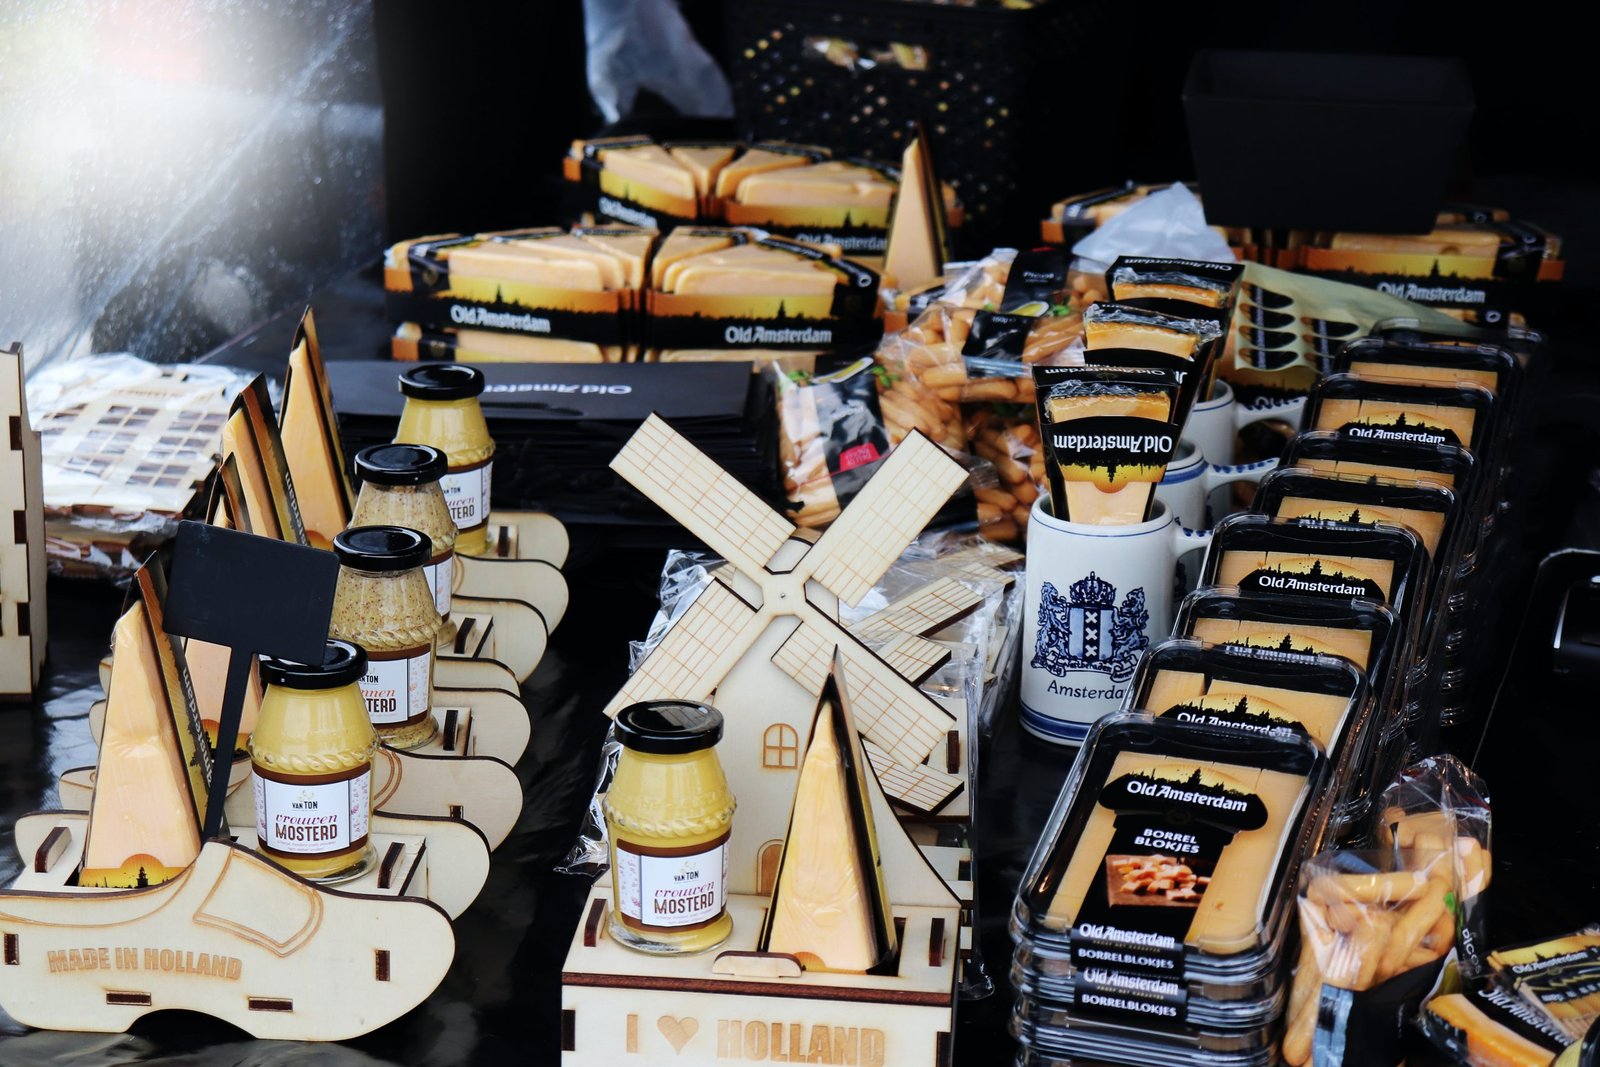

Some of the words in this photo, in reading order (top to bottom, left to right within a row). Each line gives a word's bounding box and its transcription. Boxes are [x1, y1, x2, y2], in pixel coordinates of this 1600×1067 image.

[823, 234, 888, 250] Amsterda
[1405, 283, 1486, 303] Amsterdam
[451, 304, 477, 324] Old
[475, 307, 551, 333] Amsterdam
[725, 325, 752, 343] Old
[752, 326, 832, 343] Amsterdam
[484, 383, 580, 393] Amster
[581, 384, 632, 394] Old
[1053, 434, 1142, 453] Amsterdam
[1143, 435, 1173, 453] Old
[1349, 428, 1373, 438] Old
[1372, 429, 1446, 444] Amsterdam
[451, 504, 475, 520] TERD
[1259, 575, 1285, 588] Old
[1285, 578, 1366, 596] Amsterdam
[366, 675, 379, 683] TON
[1047, 680, 1124, 699] Amsterda
[366, 698, 397, 713] TERD
[304, 801, 318, 809] TON
[1126, 780, 1158, 797] Old
[1156, 784, 1248, 812] Amsterdam
[275, 813, 338, 825] vrouwen
[275, 822, 338, 842] MOSTERD
[1143, 828, 1198, 844] BORREL
[1134, 836, 1200, 854] BLOKJES
[686, 870, 700, 880] TON
[654, 881, 715, 898] vrouwen
[654, 891, 715, 915] MOSTERD
[1079, 923, 1105, 939] Old
[1102, 926, 1176, 949] Amsterdam
[47, 947, 111, 973] MADE
[115, 947, 139, 970] IN
[144, 948, 243, 980] HOLLAND
[1078, 948, 1175, 969] BORRELBLOKJES
[1083, 967, 1109, 984] Old
[1106, 971, 1179, 995] Amsterdam
[1081, 993, 1177, 1017] BORRELBLOKJES
[626, 1014, 639, 1053] I
[717, 1019, 885, 1067] HOLLAND
